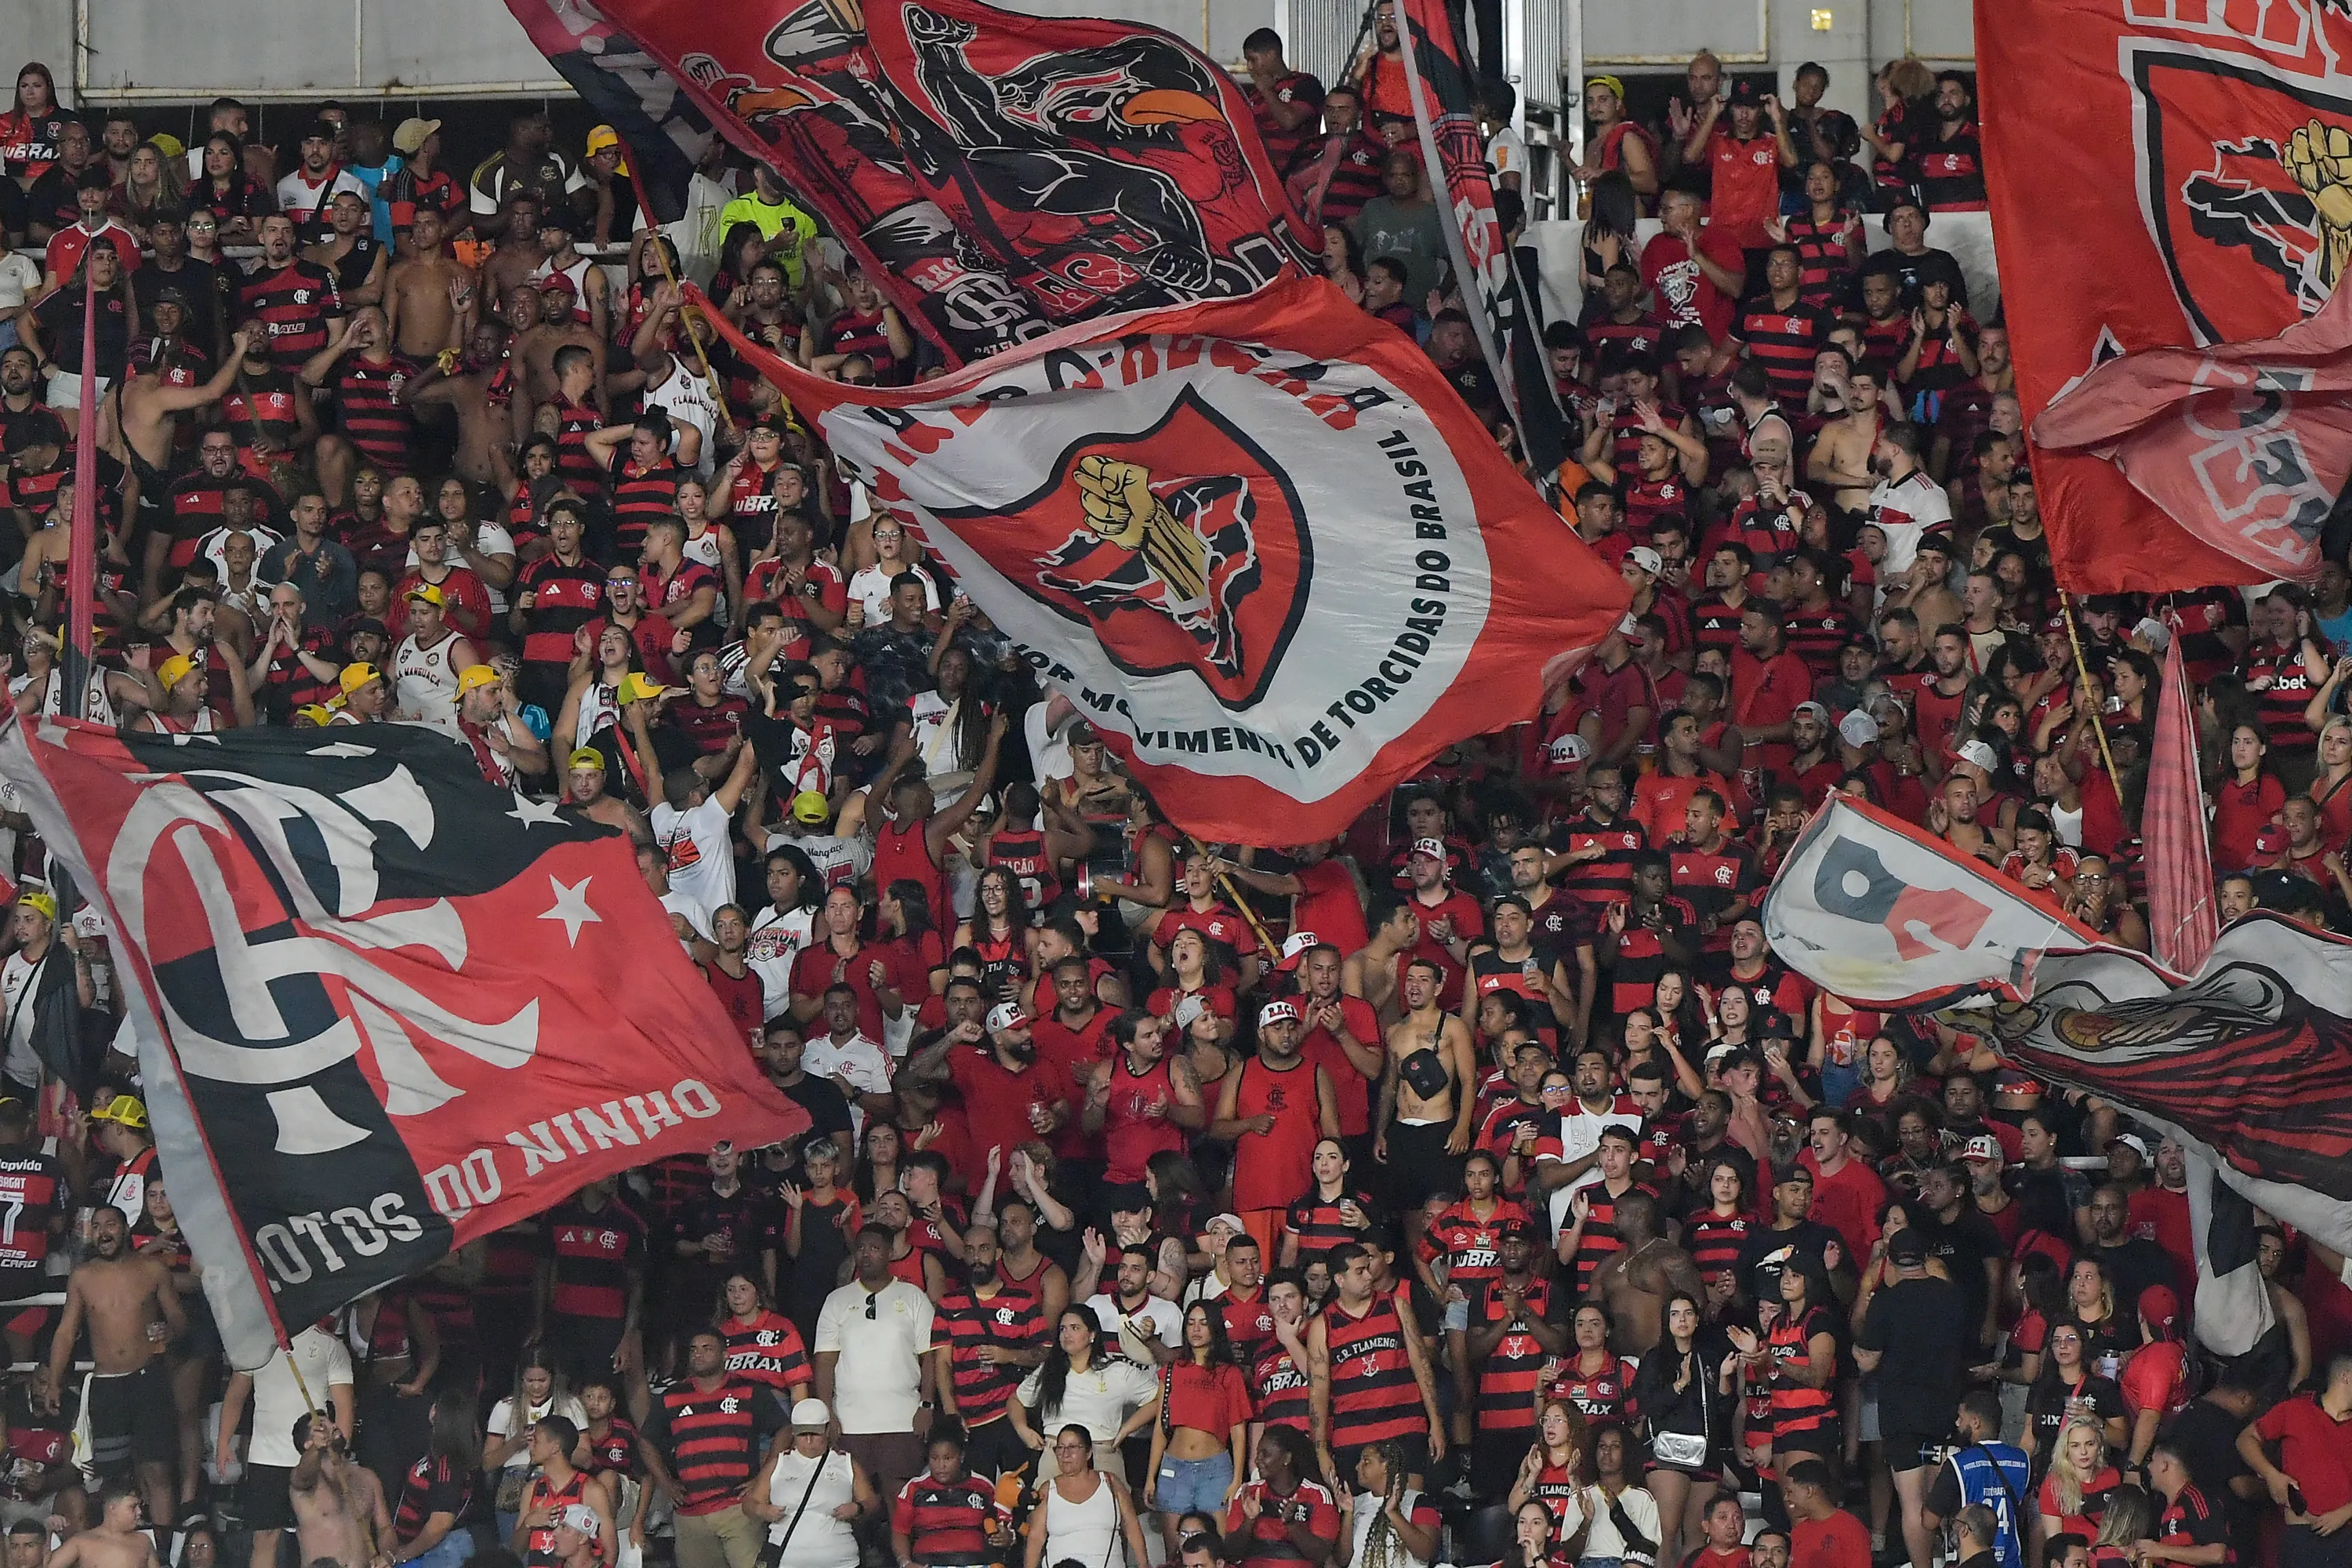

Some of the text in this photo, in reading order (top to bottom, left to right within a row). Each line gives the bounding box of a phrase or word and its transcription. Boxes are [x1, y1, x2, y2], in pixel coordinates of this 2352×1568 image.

[1377, 429, 1449, 540] BRASIL
[1415, 550, 1451, 593] DO
[1325, 597, 1446, 728] TORCIDAS
[1294, 720, 1341, 769] DE
[423, 1148, 503, 1223] DO
[505, 1079, 721, 1178] NINHO
